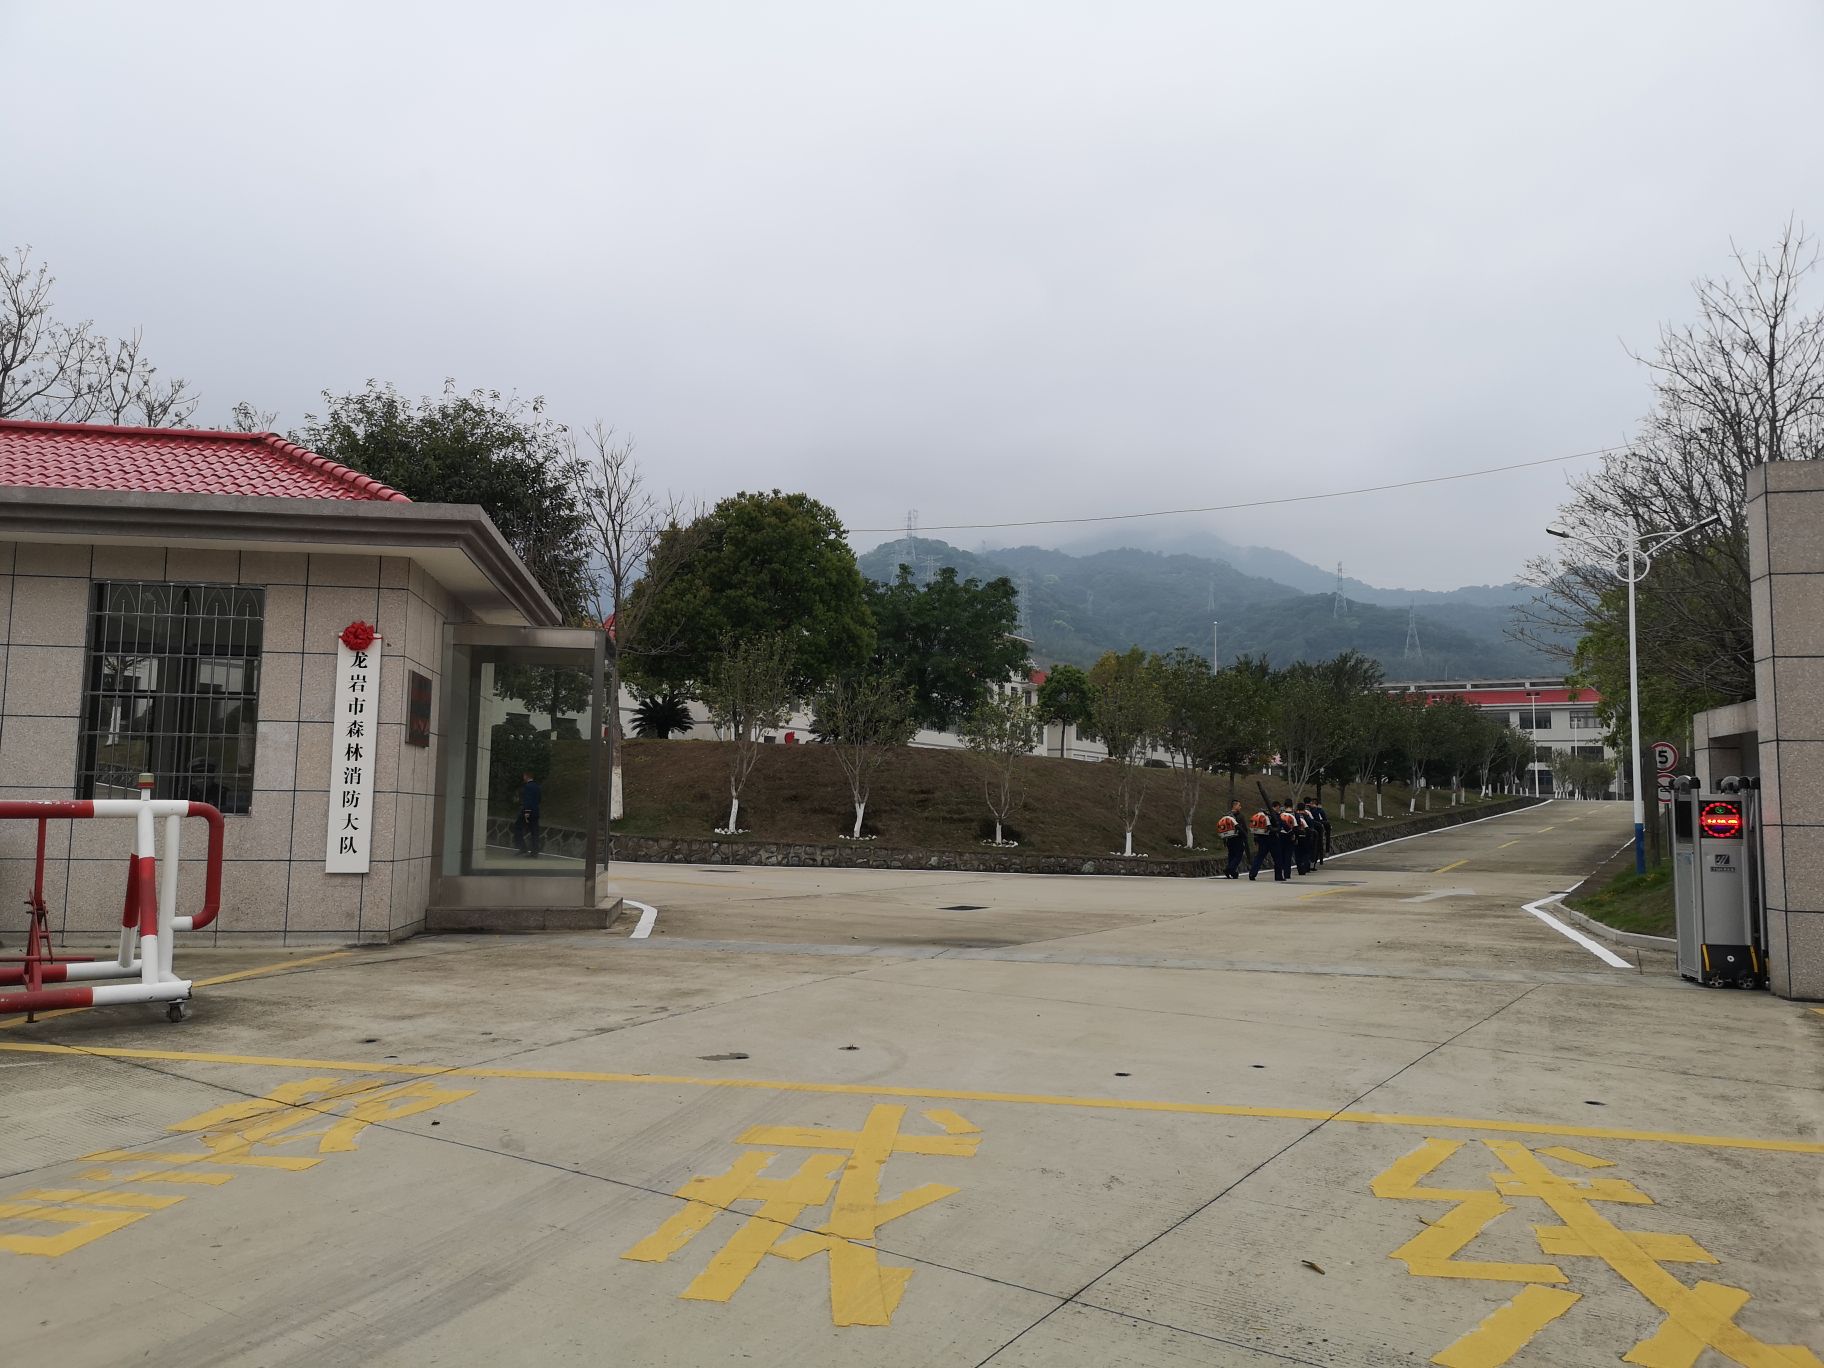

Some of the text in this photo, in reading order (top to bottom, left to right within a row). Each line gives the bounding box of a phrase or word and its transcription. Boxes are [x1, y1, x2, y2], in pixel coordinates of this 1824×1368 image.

[339, 650, 369, 855] 龙岩市森林消防大队
[1658, 750, 1668, 764] 5
